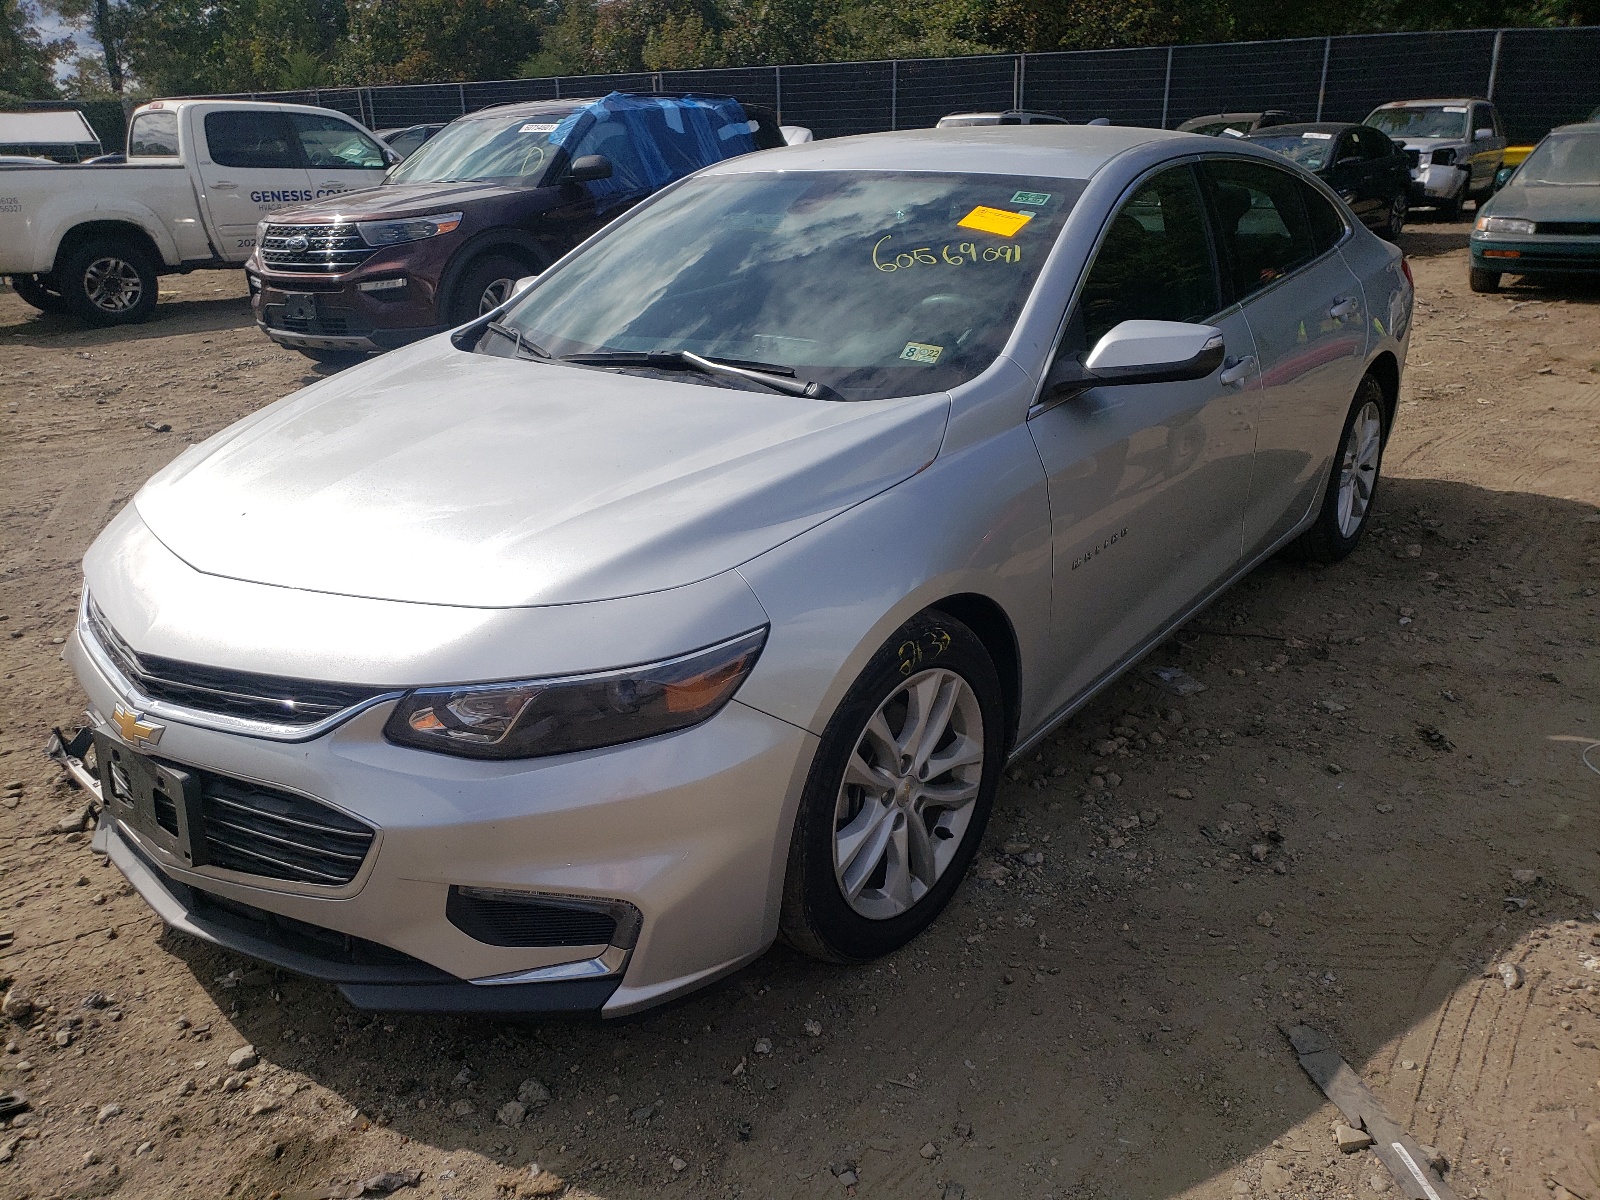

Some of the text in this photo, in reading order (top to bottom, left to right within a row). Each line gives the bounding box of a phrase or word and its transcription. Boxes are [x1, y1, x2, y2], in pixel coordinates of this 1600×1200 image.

[250, 190, 313, 203] GENESIS
[872, 234, 1021, 273] 60569091
[905, 347, 917, 358] 8
[926, 349, 940, 358] 22
